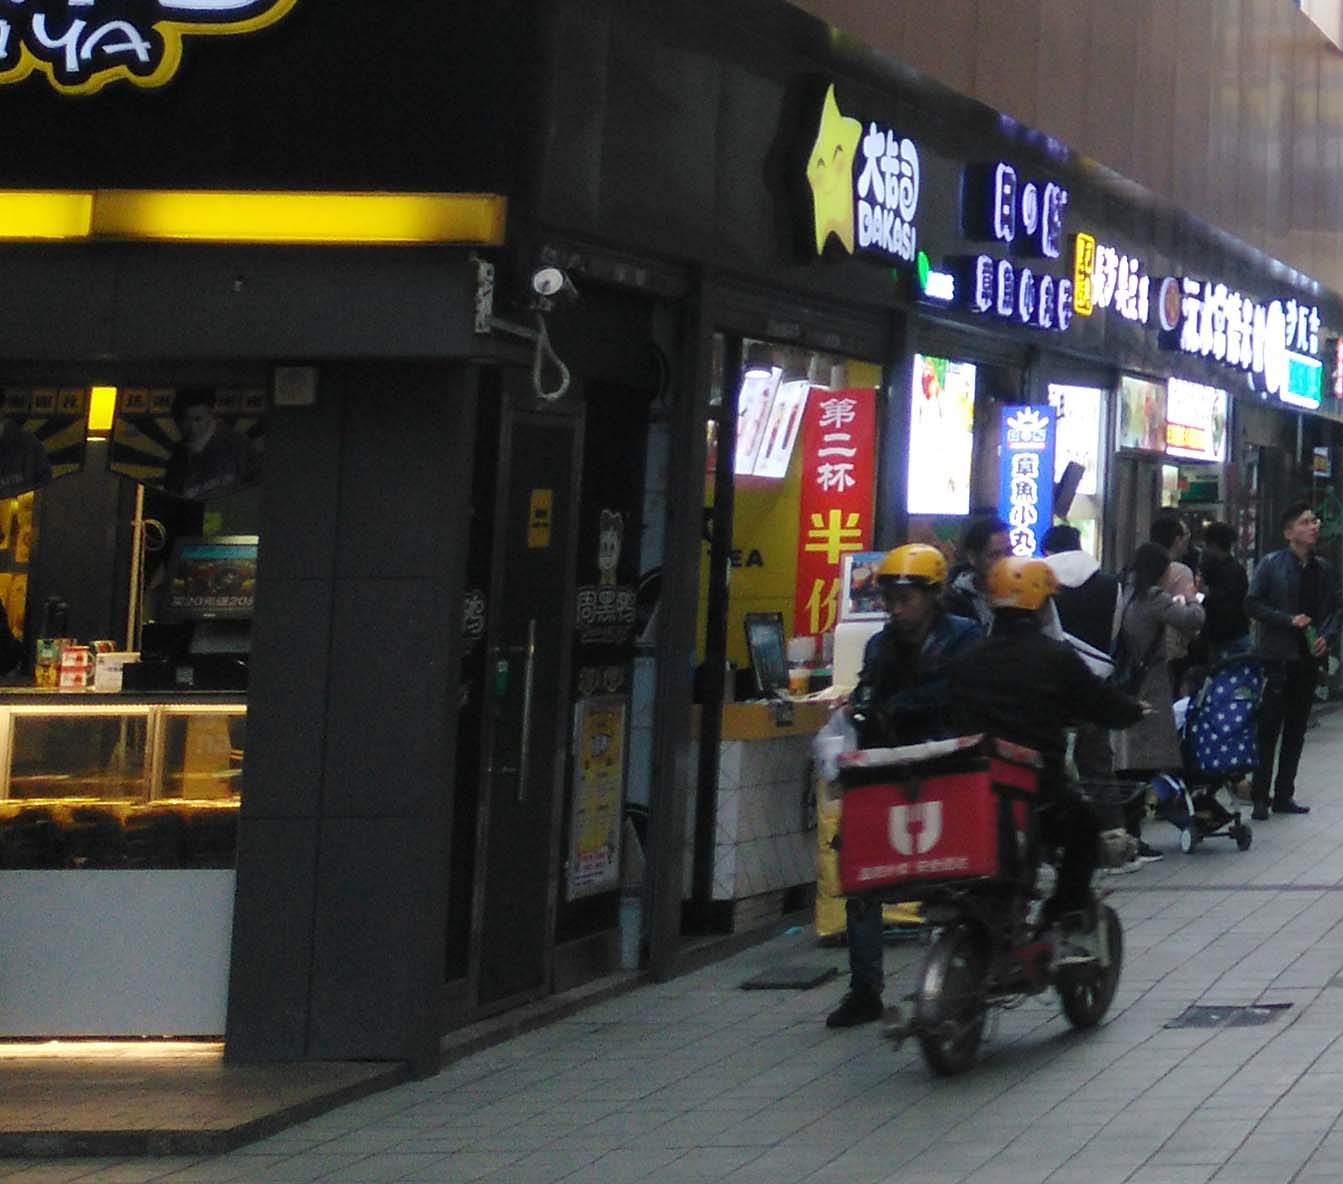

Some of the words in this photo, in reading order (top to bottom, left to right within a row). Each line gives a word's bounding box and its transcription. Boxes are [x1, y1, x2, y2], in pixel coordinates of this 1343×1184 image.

[857, 199, 917, 263] DAKASI
[816, 397, 858, 493] 第二杯
[1009, 453, 1039, 556] 章魚小丸
